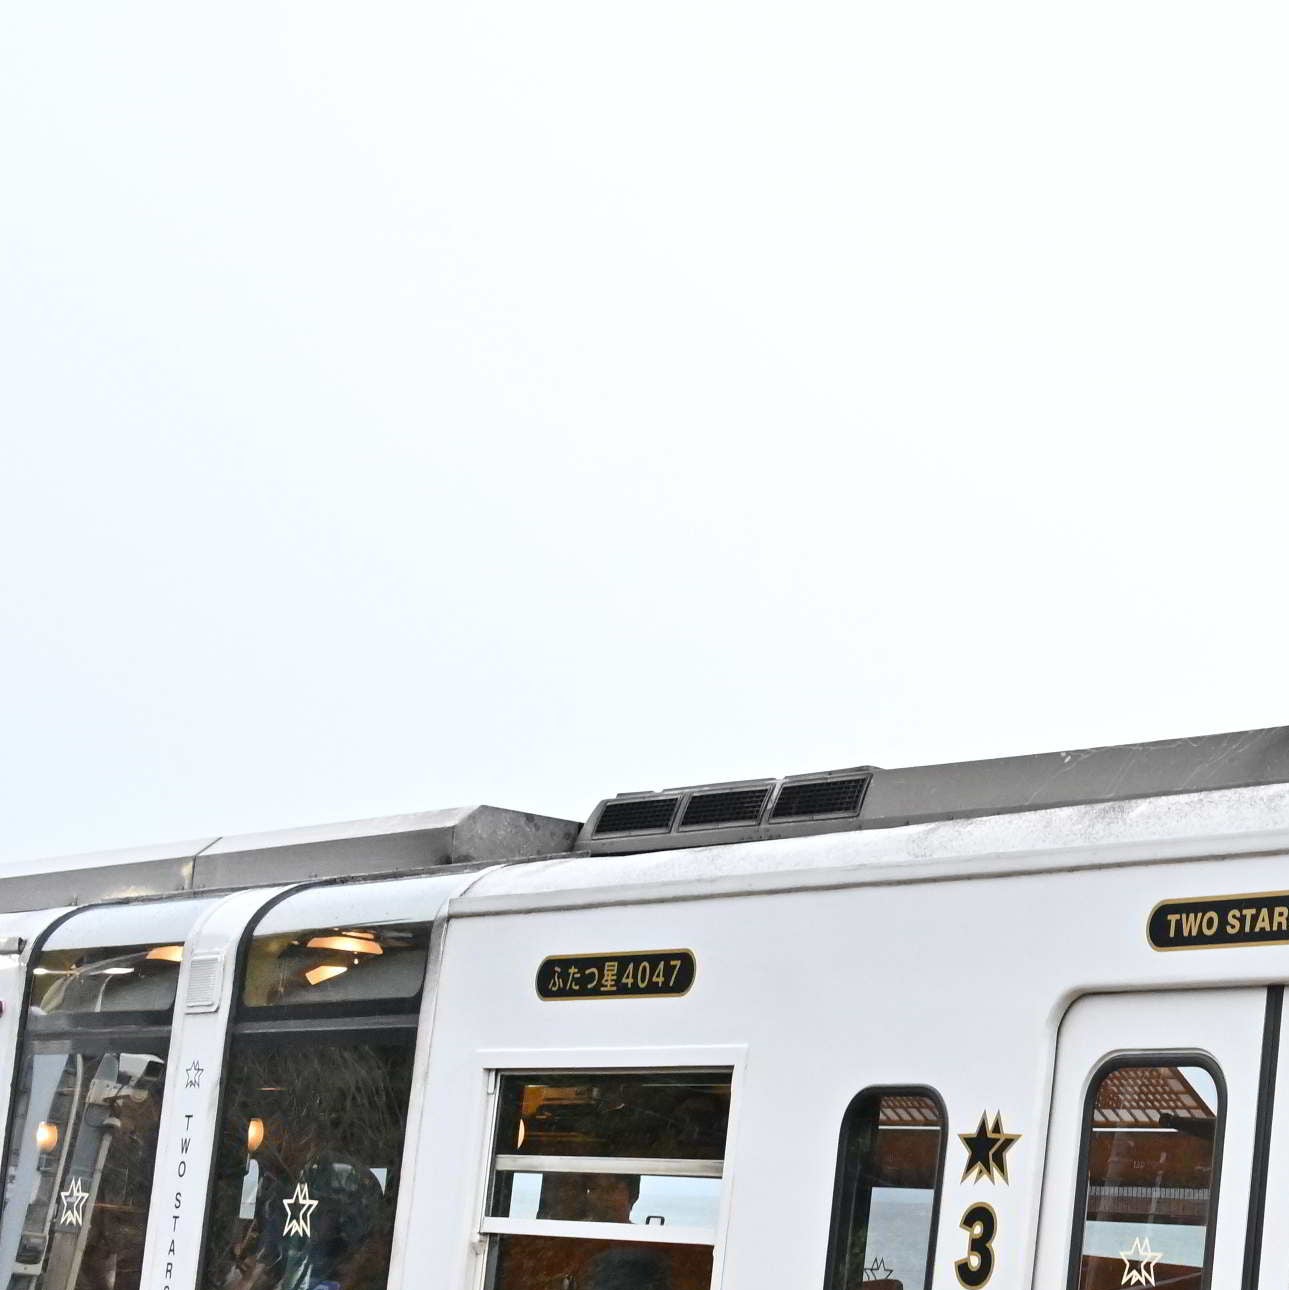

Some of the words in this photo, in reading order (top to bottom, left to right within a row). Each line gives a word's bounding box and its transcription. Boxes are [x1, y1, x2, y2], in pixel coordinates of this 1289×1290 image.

[1167, 910, 1219, 938] TWO
[548, 960, 682, 991] ふたつ星4047
[178, 1115, 193, 1178] TWO
[955, 1202, 998, 1290] 3
